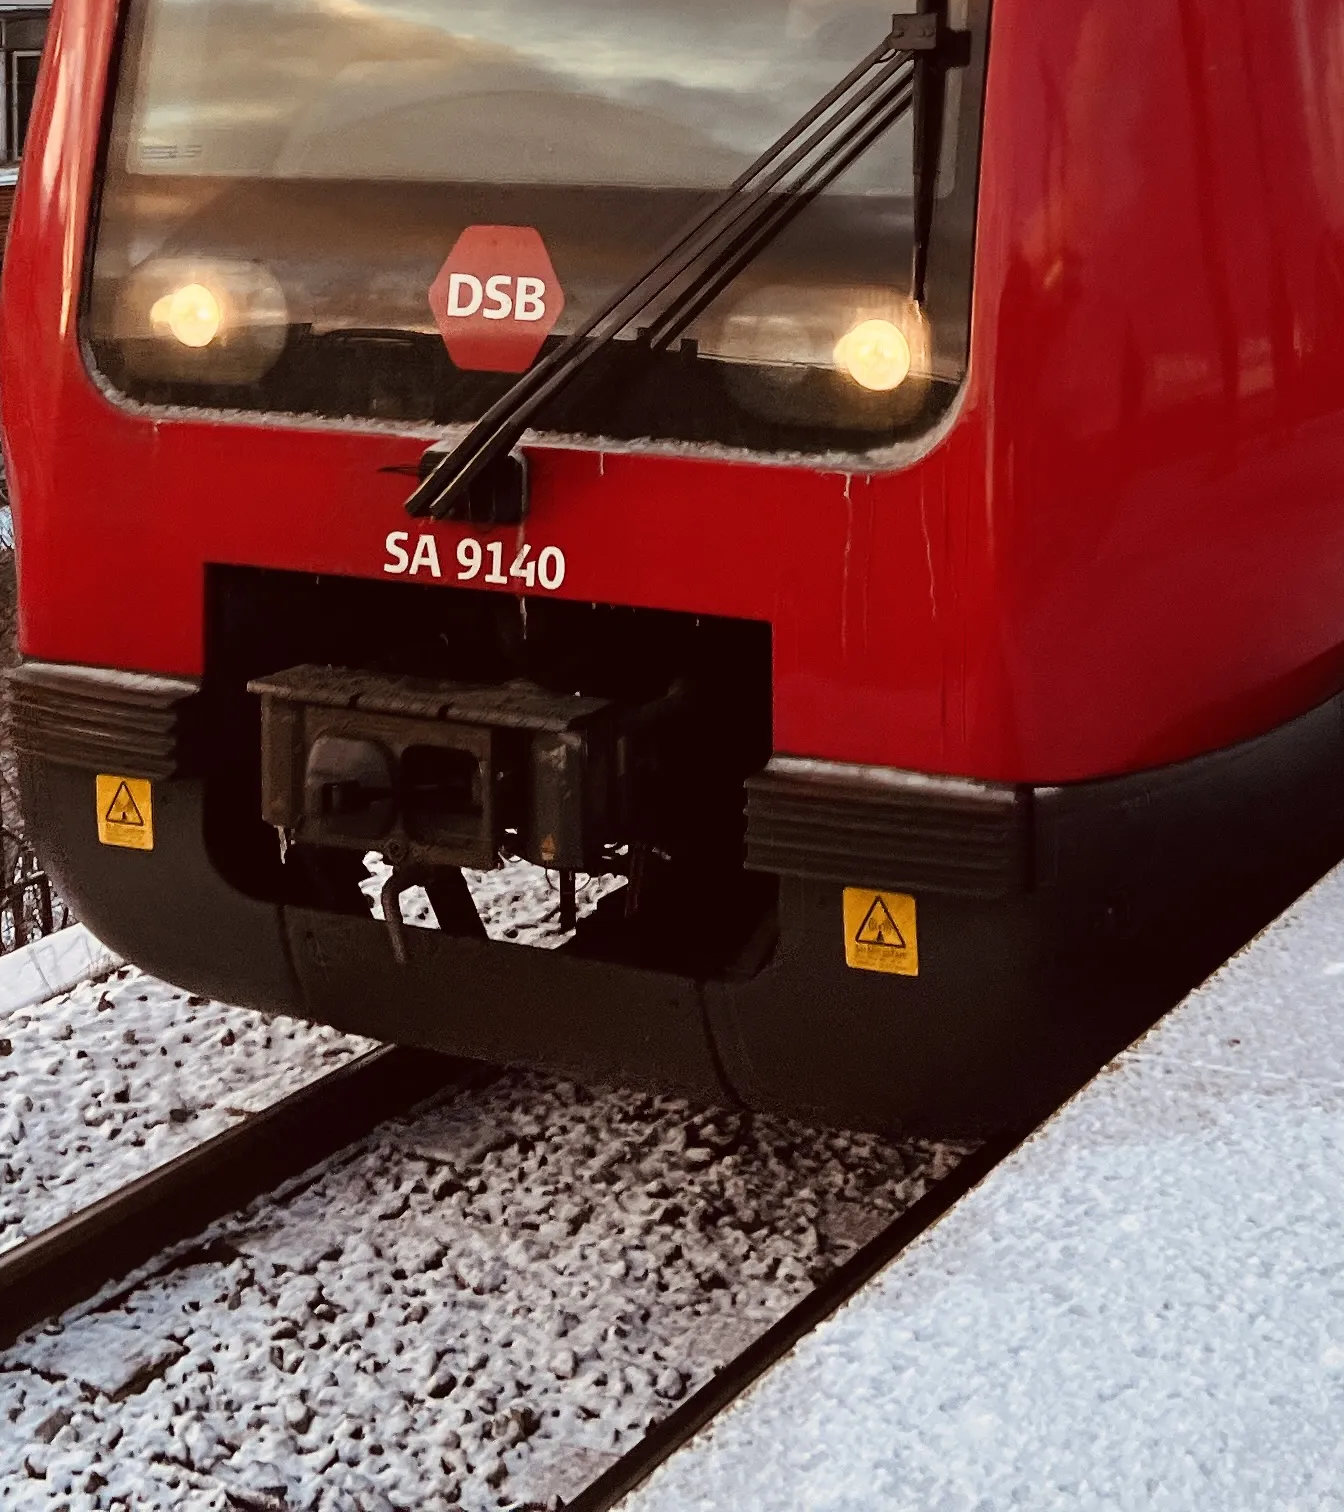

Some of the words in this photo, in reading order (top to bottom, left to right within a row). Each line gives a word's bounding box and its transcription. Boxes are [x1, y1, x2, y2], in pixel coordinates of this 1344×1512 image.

[446, 273, 547, 322] DSB
[383, 531, 442, 578] SA
[456, 538, 566, 590] 9140
